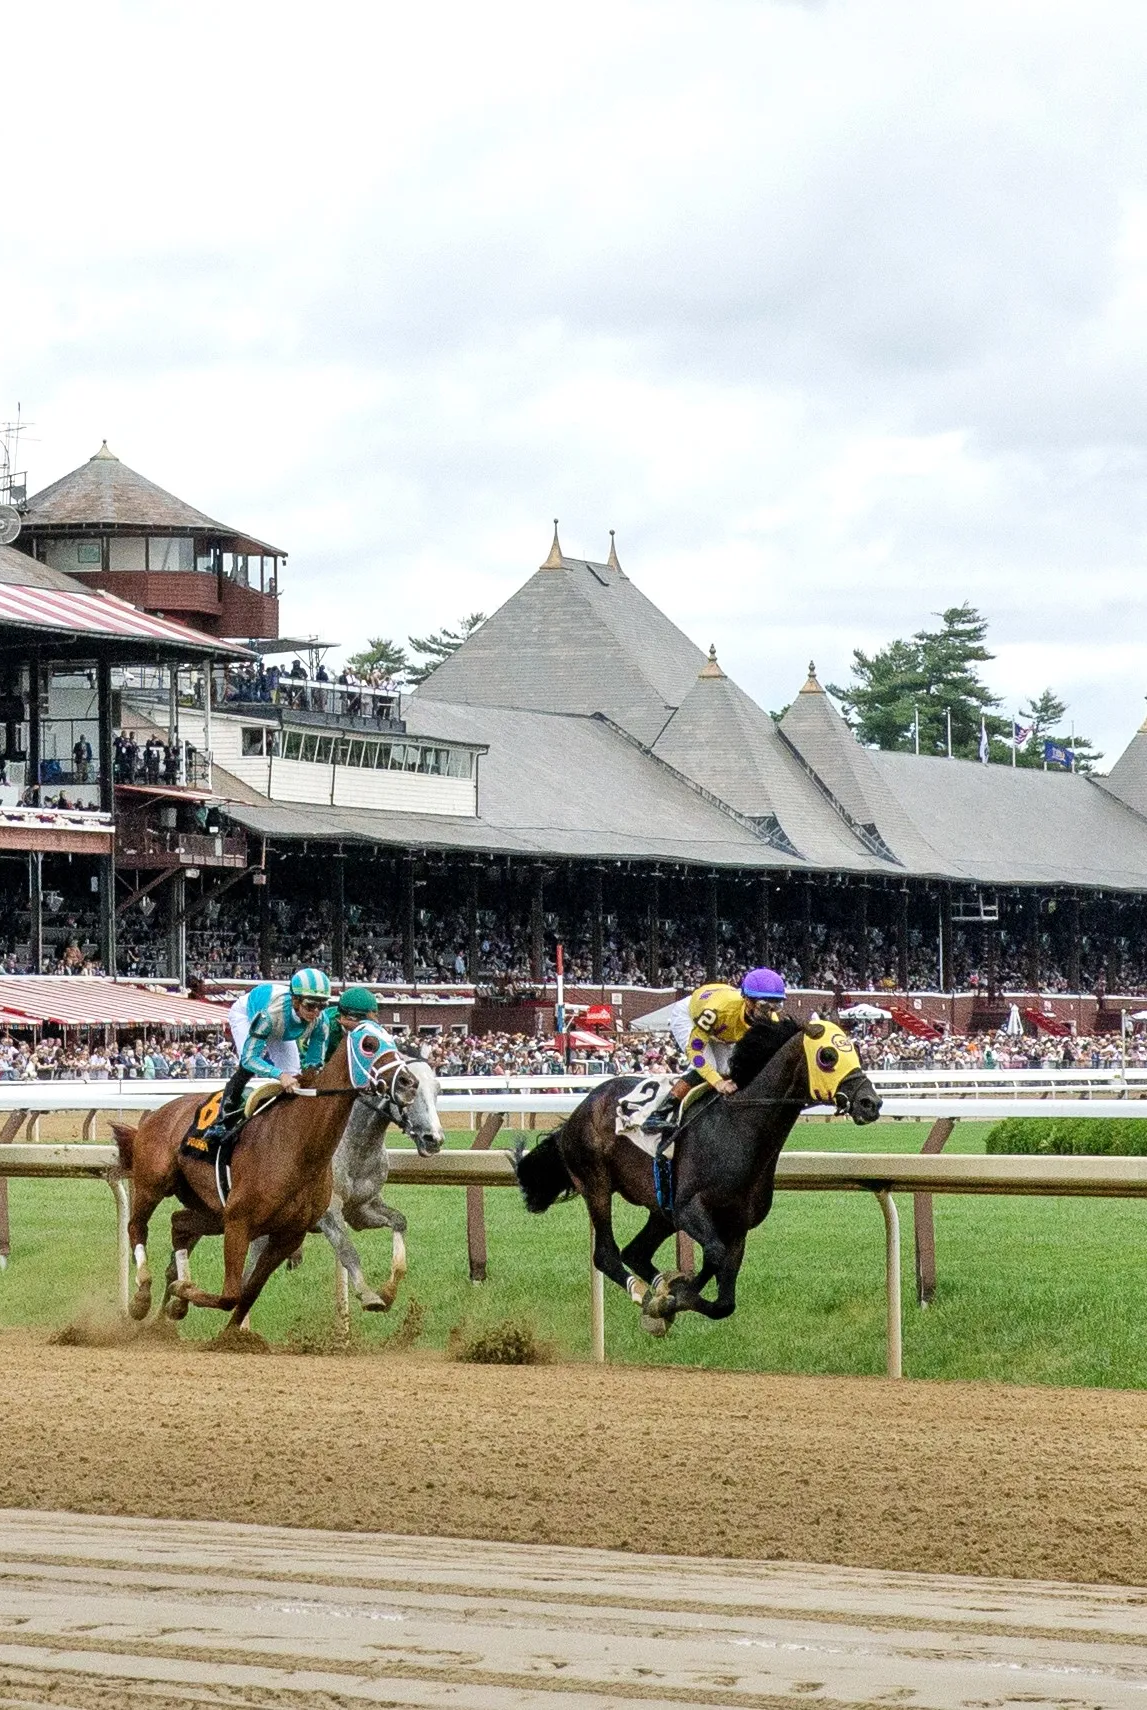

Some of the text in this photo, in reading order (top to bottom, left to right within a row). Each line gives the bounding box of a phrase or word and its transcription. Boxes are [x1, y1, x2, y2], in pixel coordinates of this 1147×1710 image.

[697, 1009, 717, 1031] 2
[197, 1090, 224, 1130] 6
[621, 1081, 660, 1117] 2
